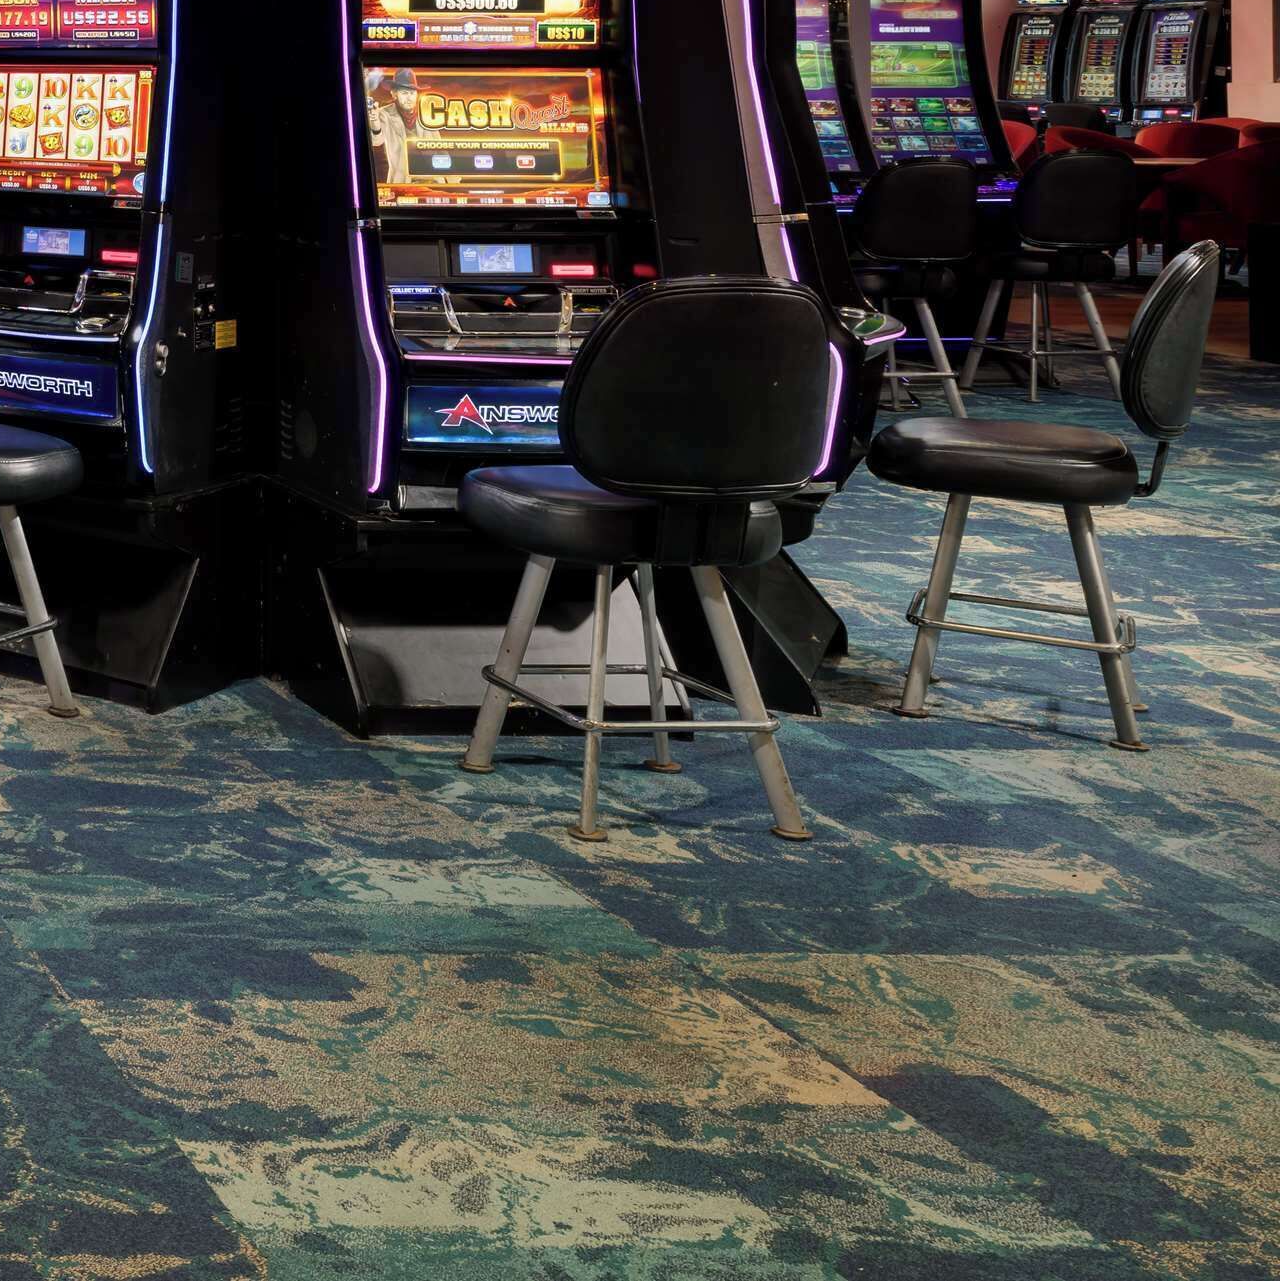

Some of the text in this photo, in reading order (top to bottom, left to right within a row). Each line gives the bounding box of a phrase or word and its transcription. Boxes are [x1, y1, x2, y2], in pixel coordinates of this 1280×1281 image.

[63, 10, 149, 25] US$22.56
[368, 26, 406, 40] US$50
[547, 26, 585, 41] US$10
[418, 94, 569, 131] CASH Quest
[416, 141, 550, 150] CHOOSE YOUR DENOMINATION
[435, 394, 559, 435] AINSW
